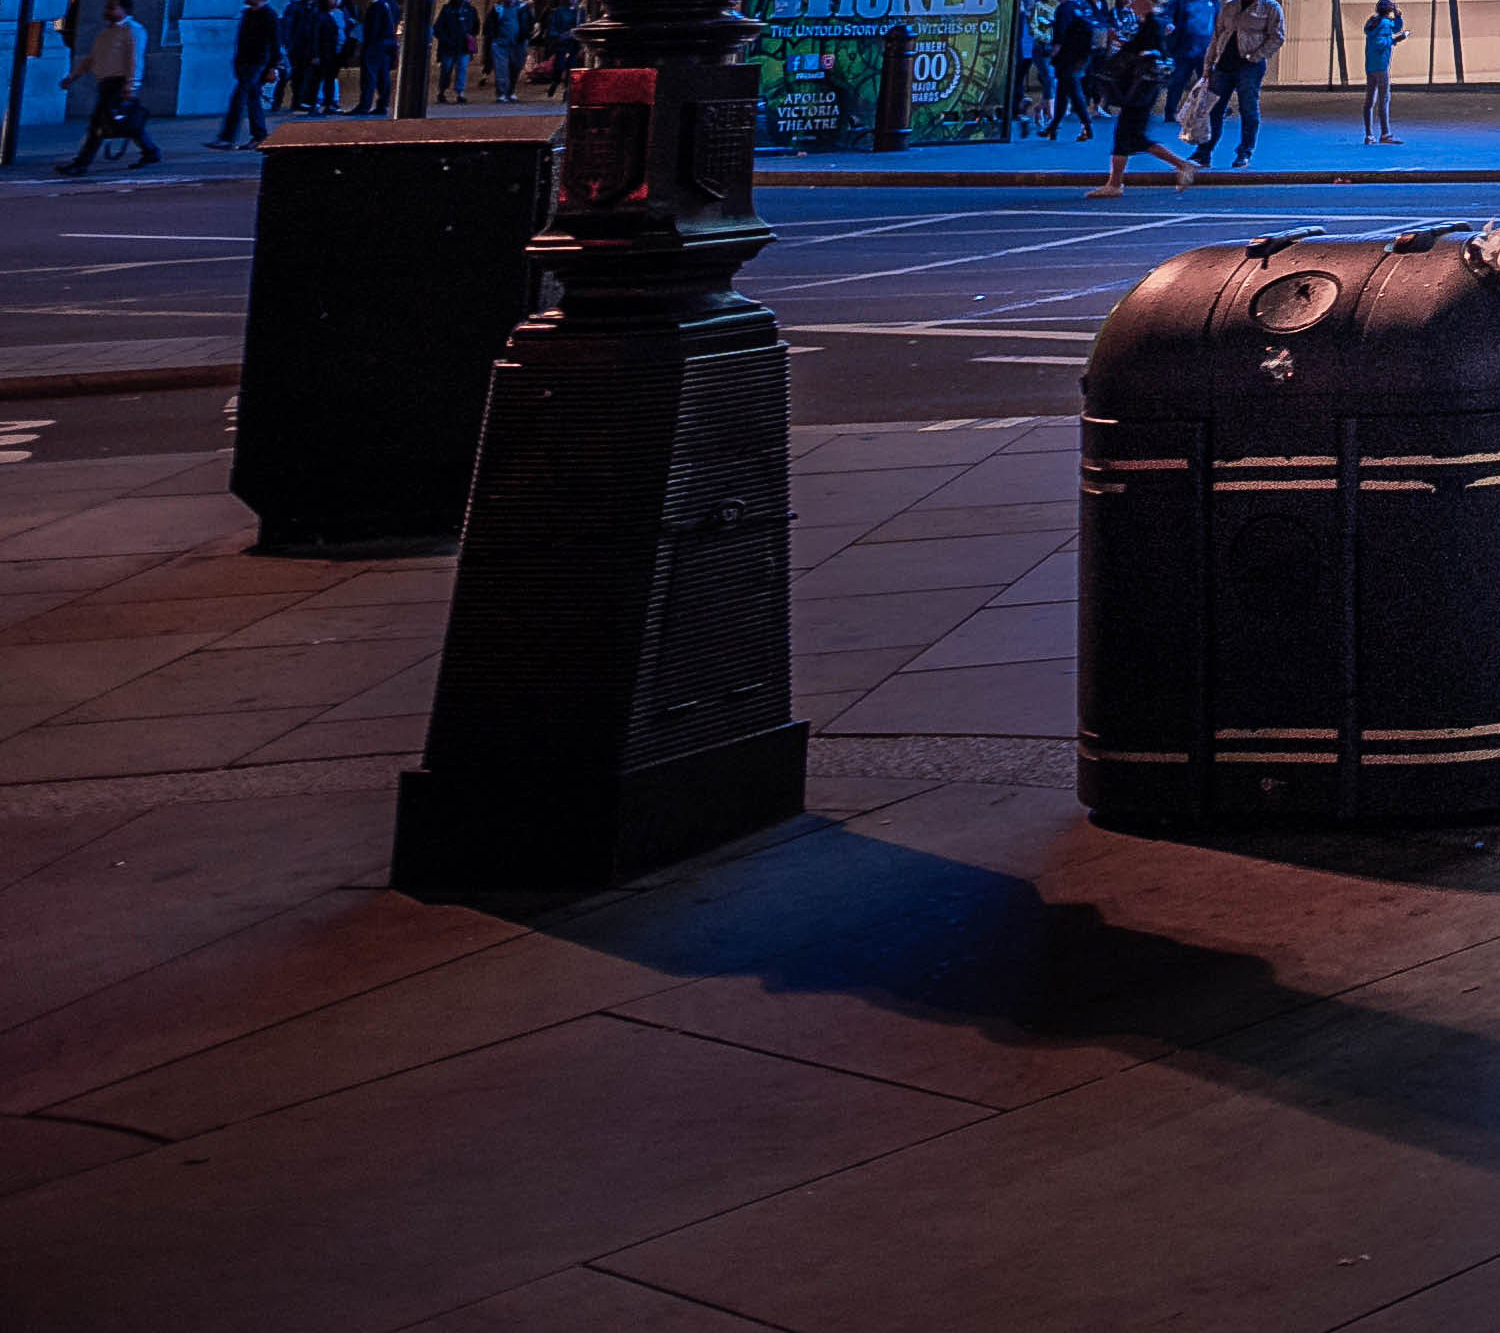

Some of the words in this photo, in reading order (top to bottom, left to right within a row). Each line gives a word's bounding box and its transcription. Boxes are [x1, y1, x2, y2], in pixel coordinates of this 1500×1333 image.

[783, 91, 836, 104] APOLLO
[777, 104, 840, 118] VICTORIA
[777, 118, 837, 132] THEATRE
